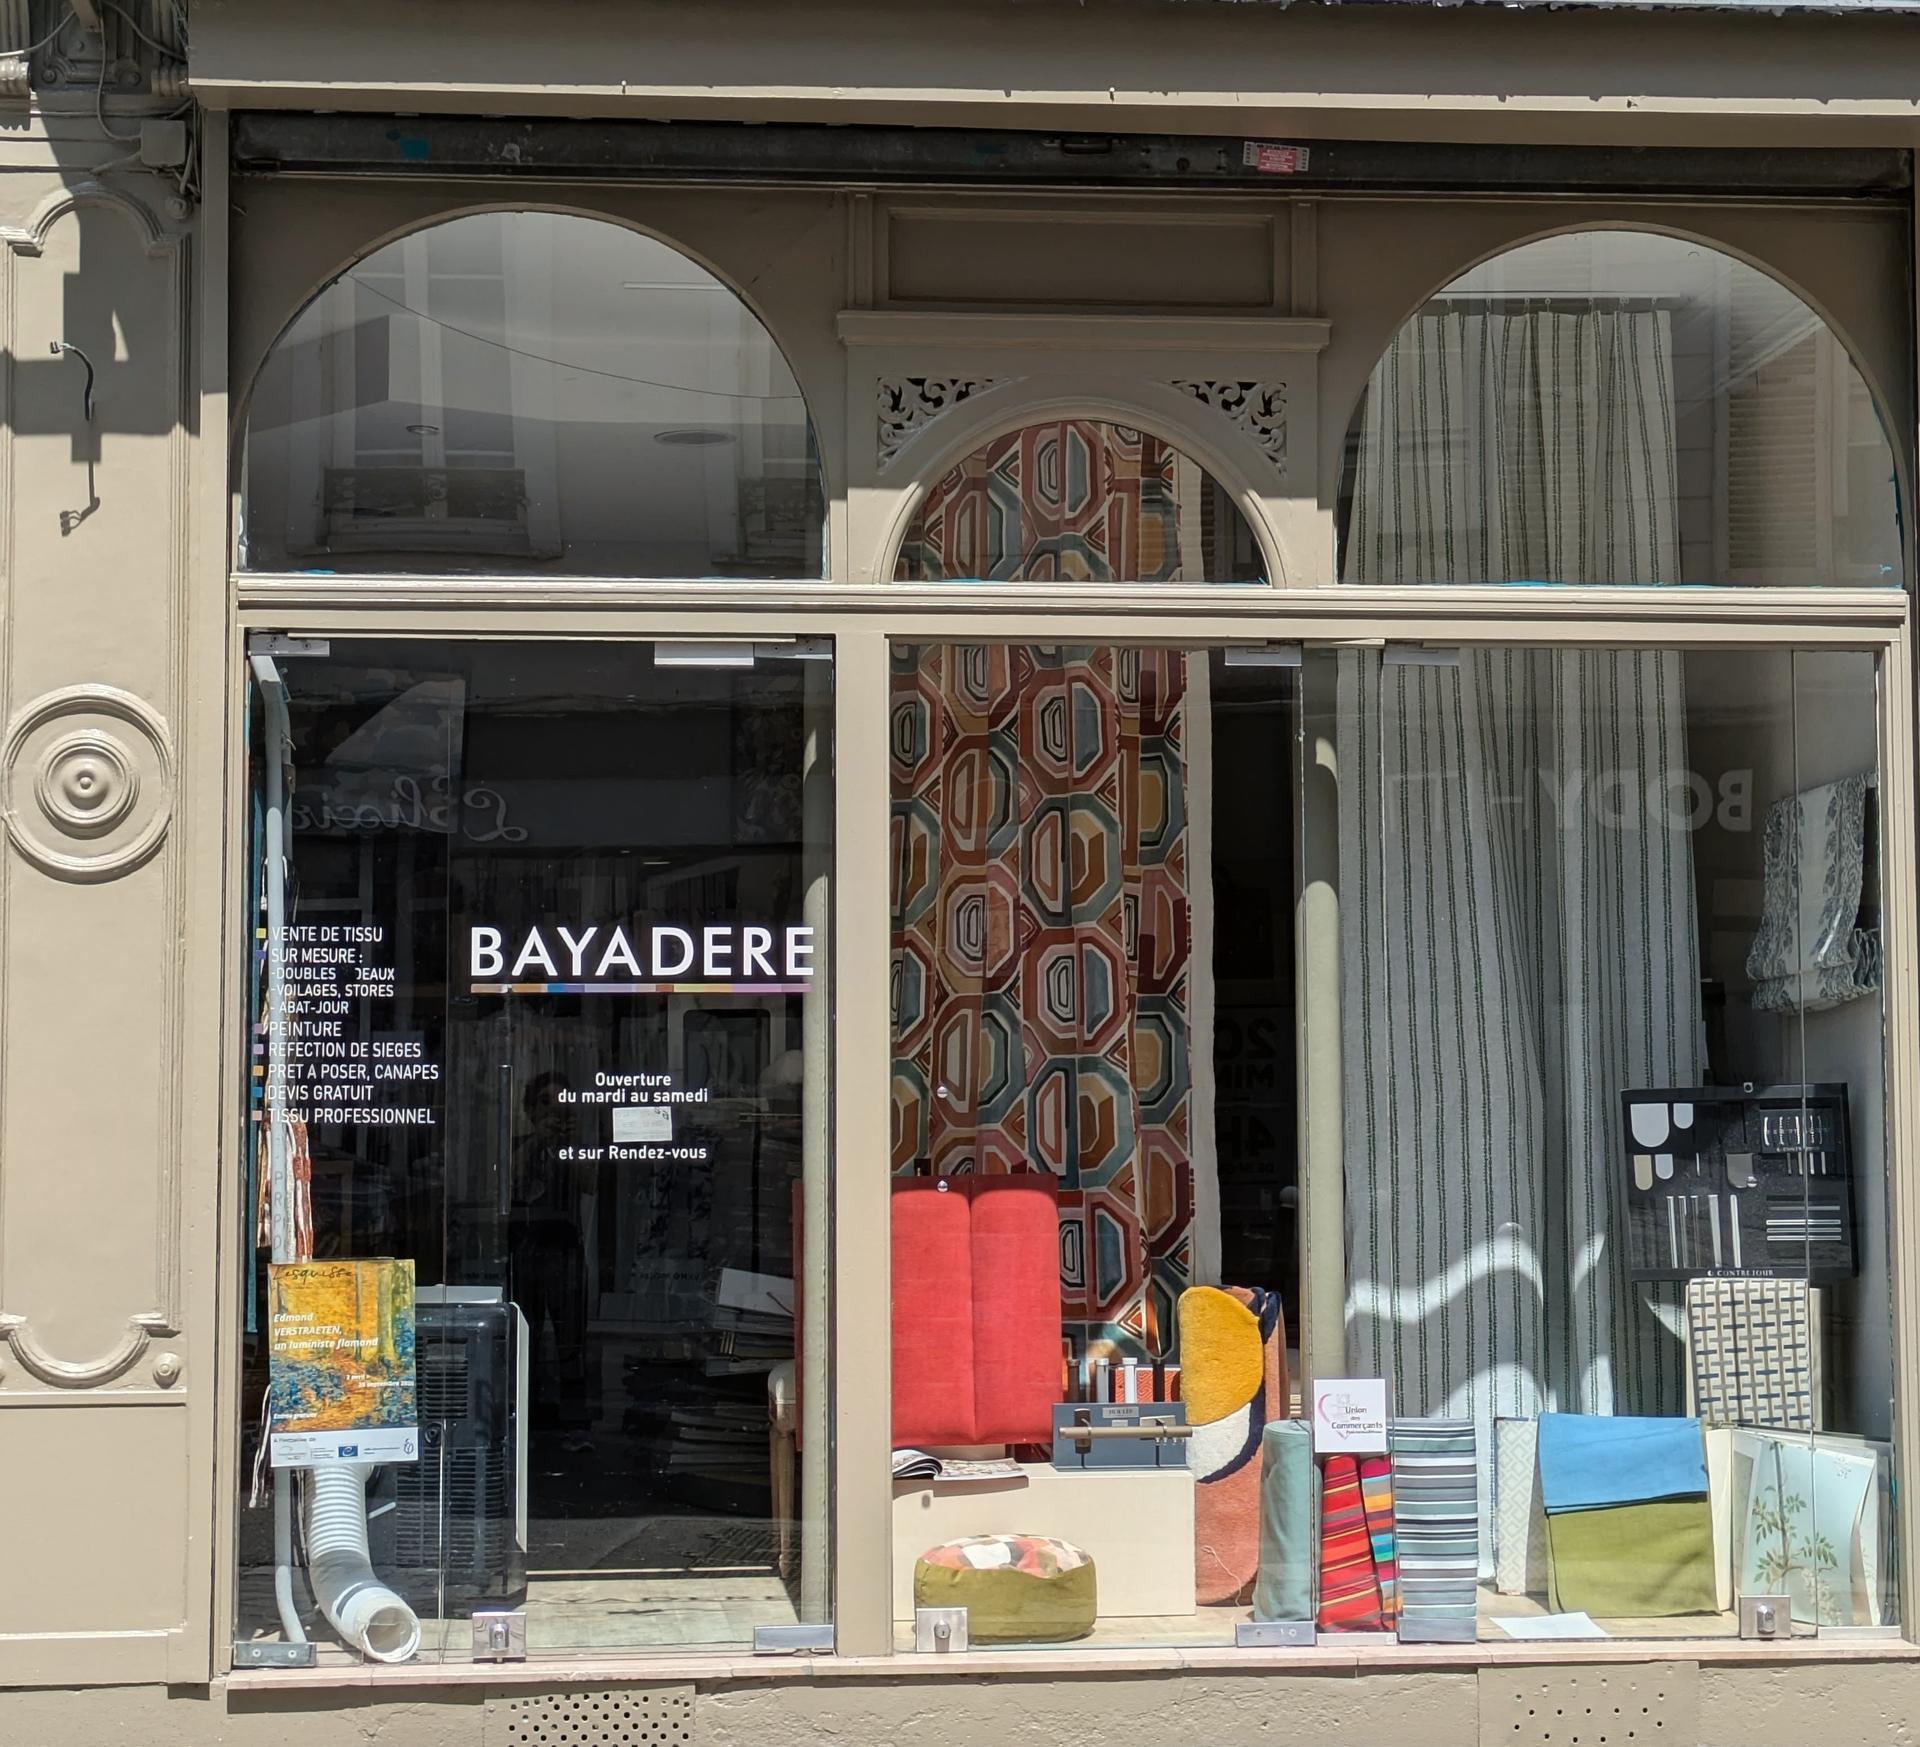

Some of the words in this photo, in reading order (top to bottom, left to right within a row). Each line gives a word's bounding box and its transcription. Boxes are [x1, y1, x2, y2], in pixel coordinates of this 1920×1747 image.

[271, 926, 317, 943] VENTE
[320, 926, 340, 943] DE
[343, 926, 383, 943] TISSU
[271, 948, 298, 964] SUR
[301, 948, 356, 965] MESURE
[470, 926, 815, 977] BAYADERE
[345, 984, 394, 998] STORES
[268, 1021, 342, 1037] PEINTURE
[268, 1042, 346, 1058] REFECTION
[350, 1042, 369, 1058] DE
[372, 1042, 421, 1058] SIEGES
[268, 1063, 303, 1080] PRET
[307, 1064, 317, 1079] A
[321, 1064, 371, 1081] POSER,
[374, 1063, 439, 1080] CANAPES
[595, 1072, 672, 1087] Ouverture
[267, 1085, 309, 1101] DEVIS
[313, 1085, 374, 1101] GRATUIT
[558, 1088, 577, 1103] du
[581, 1088, 626, 1103] mardi
[631, 1091, 649, 1103] au
[653, 1087, 709, 1103] samedi
[267, 1108, 309, 1124] TISSU
[313, 1108, 436, 1124] PROFESSIONNEL
[558, 1147, 574, 1160] et
[578, 1149, 604, 1160] sur
[609, 1145, 707, 1160] Rendez-vous
[273, 1312, 314, 1323] Edmond
[1345, 1406, 1368, 1415] Union
[1331, 1421, 1384, 1431] Commerçants
